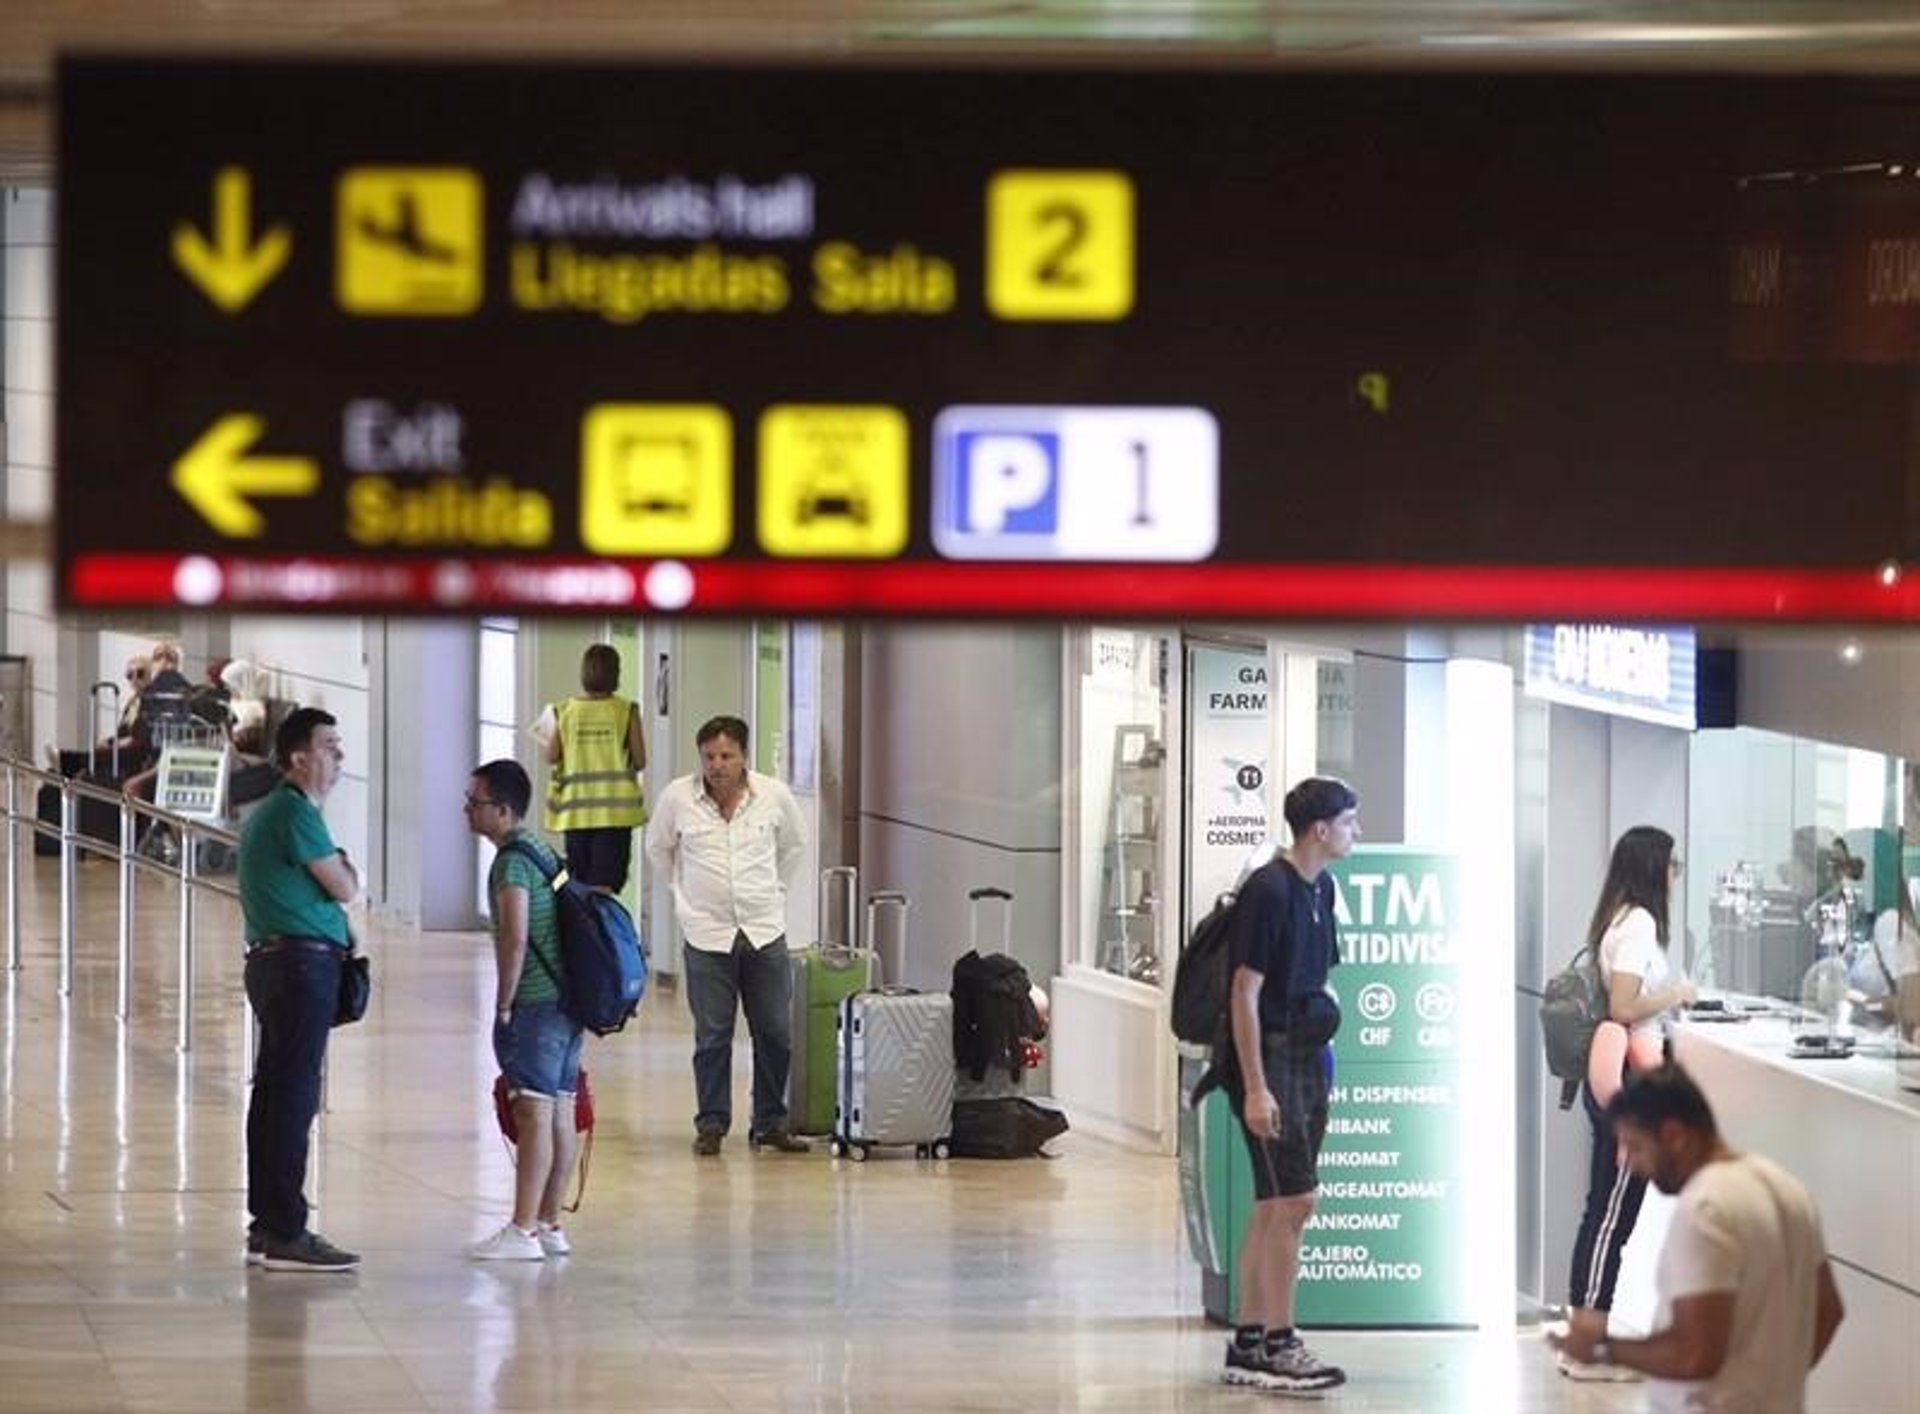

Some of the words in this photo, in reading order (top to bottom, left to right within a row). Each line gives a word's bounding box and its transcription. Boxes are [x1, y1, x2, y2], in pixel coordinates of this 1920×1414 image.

[512, 174, 712, 238] Arrivals
[717, 174, 813, 237] hall
[1031, 200, 1089, 291] 2
[511, 244, 789, 321] Llegadas
[812, 242, 956, 312] Sala
[344, 400, 461, 470] Exit
[348, 476, 552, 547] Salida
[968, 433, 1052, 536] P
[1130, 440, 1154, 529] 1
[1360, 1027, 1392, 1046] CHF
[1316, 1182, 1450, 1199] NGEAUTOMAT
[1298, 1245, 1368, 1262] CAJERO
[1298, 1261, 1423, 1281] AUTOMÁTICO
